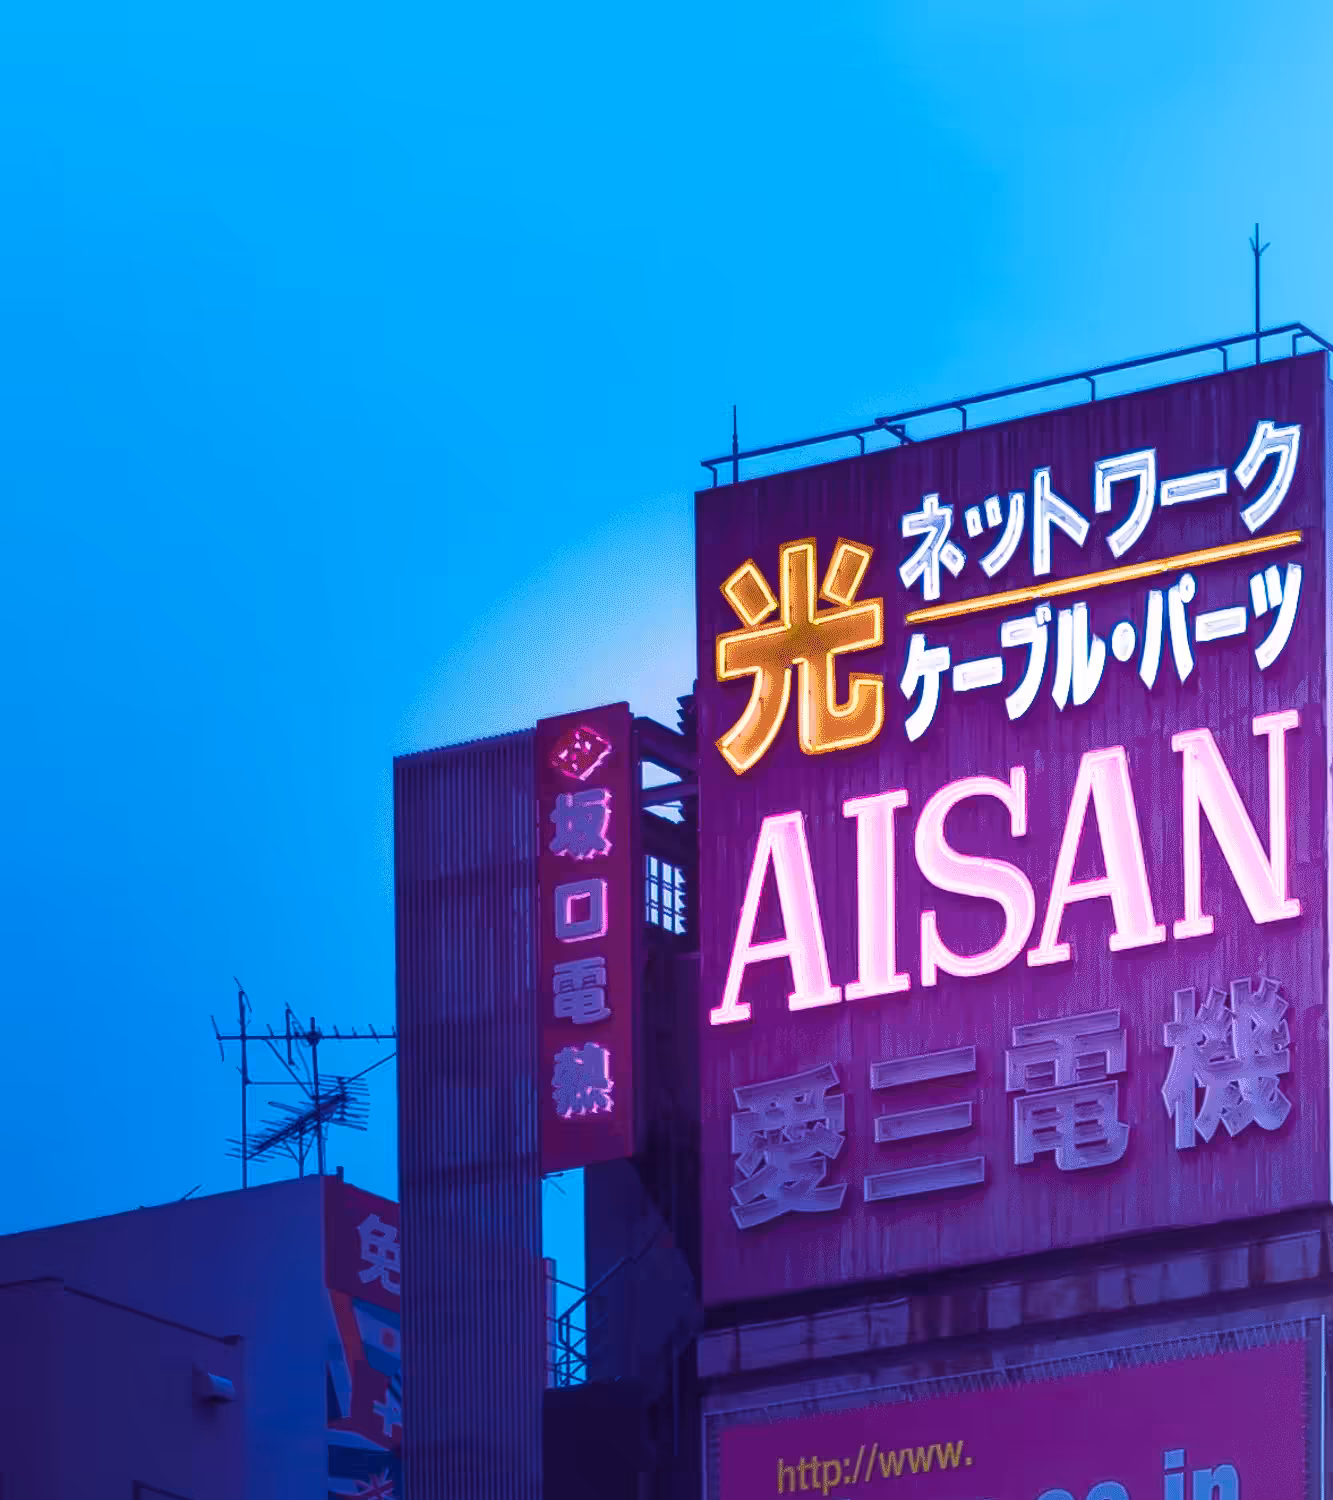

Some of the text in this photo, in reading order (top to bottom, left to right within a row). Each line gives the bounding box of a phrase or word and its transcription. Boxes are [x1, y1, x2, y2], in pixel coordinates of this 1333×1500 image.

[899, 420, 1303, 601] ネットワーク
[716, 537, 885, 774] 光
[899, 562, 1303, 742] ケーブル・パーツ
[549, 792, 613, 1120] 坂口電熱
[711, 710, 1301, 1025] AISAN
[730, 976, 1295, 1230] 愛三電機
[777, 1440, 973, 1495] http://www.
